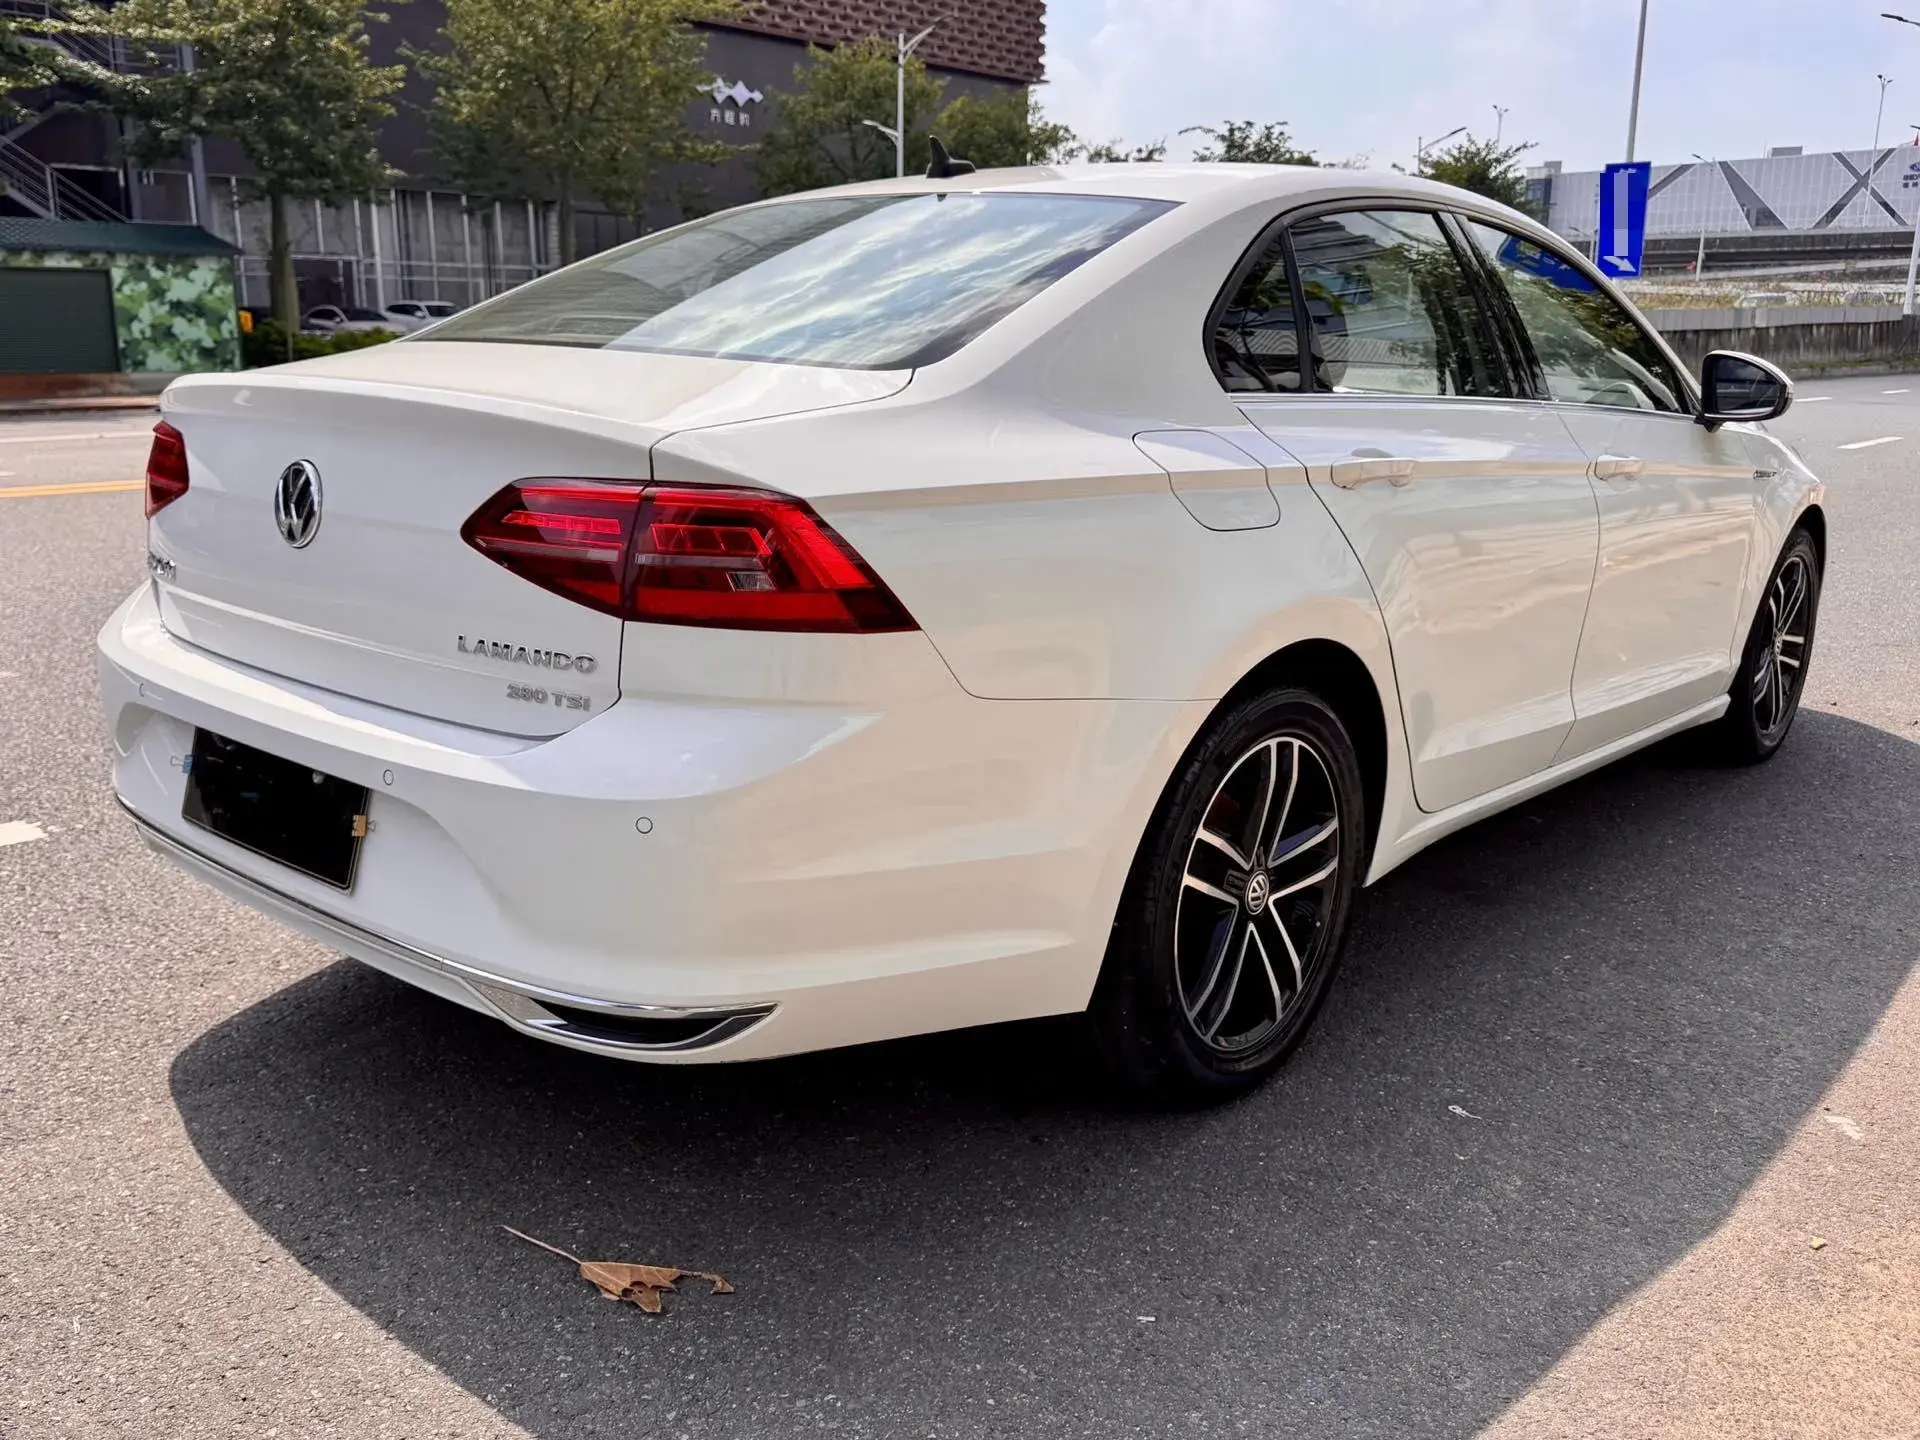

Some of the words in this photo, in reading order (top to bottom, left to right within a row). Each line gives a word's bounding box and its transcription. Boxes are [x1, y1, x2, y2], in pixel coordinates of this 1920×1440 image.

[457, 634, 598, 673] LAMANDO
[506, 683, 549, 703] 280
[551, 692, 591, 712] TSI
